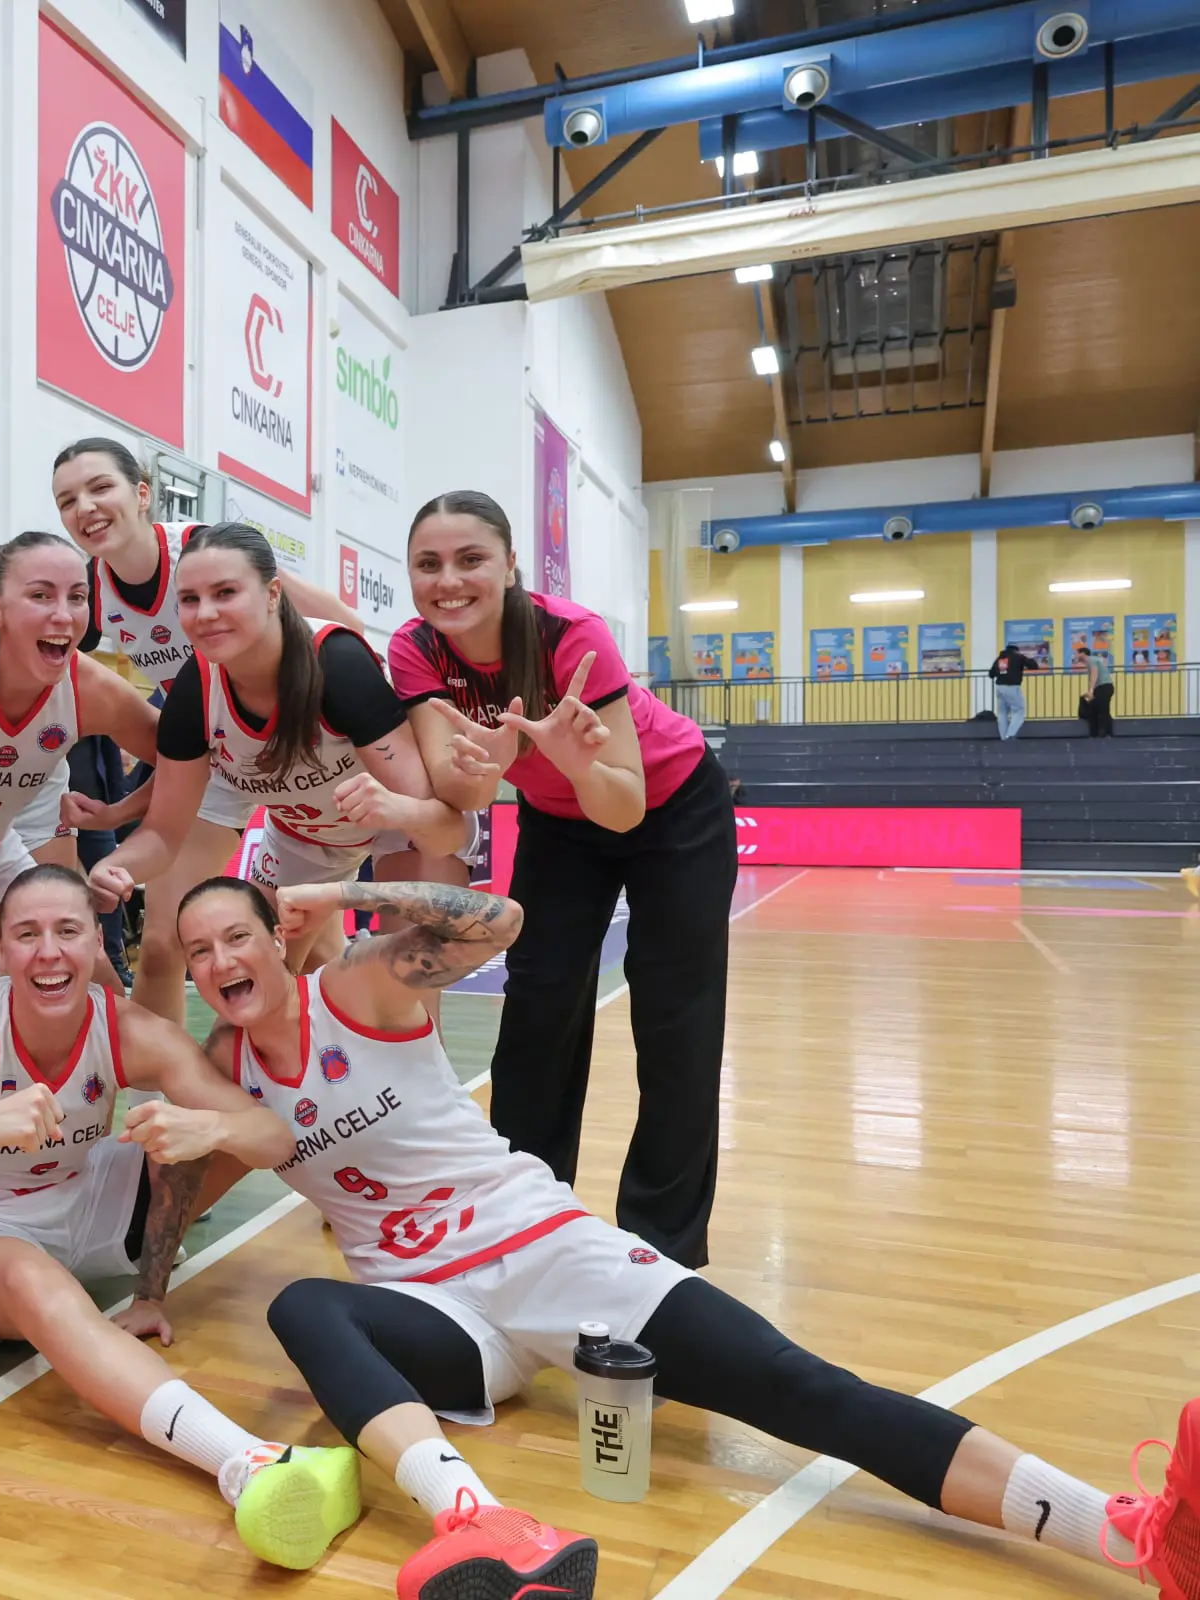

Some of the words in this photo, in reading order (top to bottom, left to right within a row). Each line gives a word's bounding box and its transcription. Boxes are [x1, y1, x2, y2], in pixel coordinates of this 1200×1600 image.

[93, 144, 139, 225] ŽKK
[59, 188, 167, 304] CINKARNA
[348, 221, 385, 277] CINKARNA
[97, 294, 135, 338] CELJE
[336, 346, 399, 430] simbio
[231, 386, 293, 452] CINKARNA
[360, 567, 394, 614] triglav
[18, 772, 48, 788] CEL
[294, 752, 356, 791] CELJE
[72, 1122, 105, 1144] CEL
[334, 1087, 402, 1138] CELJE
[334, 1166, 388, 1200] 9
[591, 1410, 623, 1464] THE
